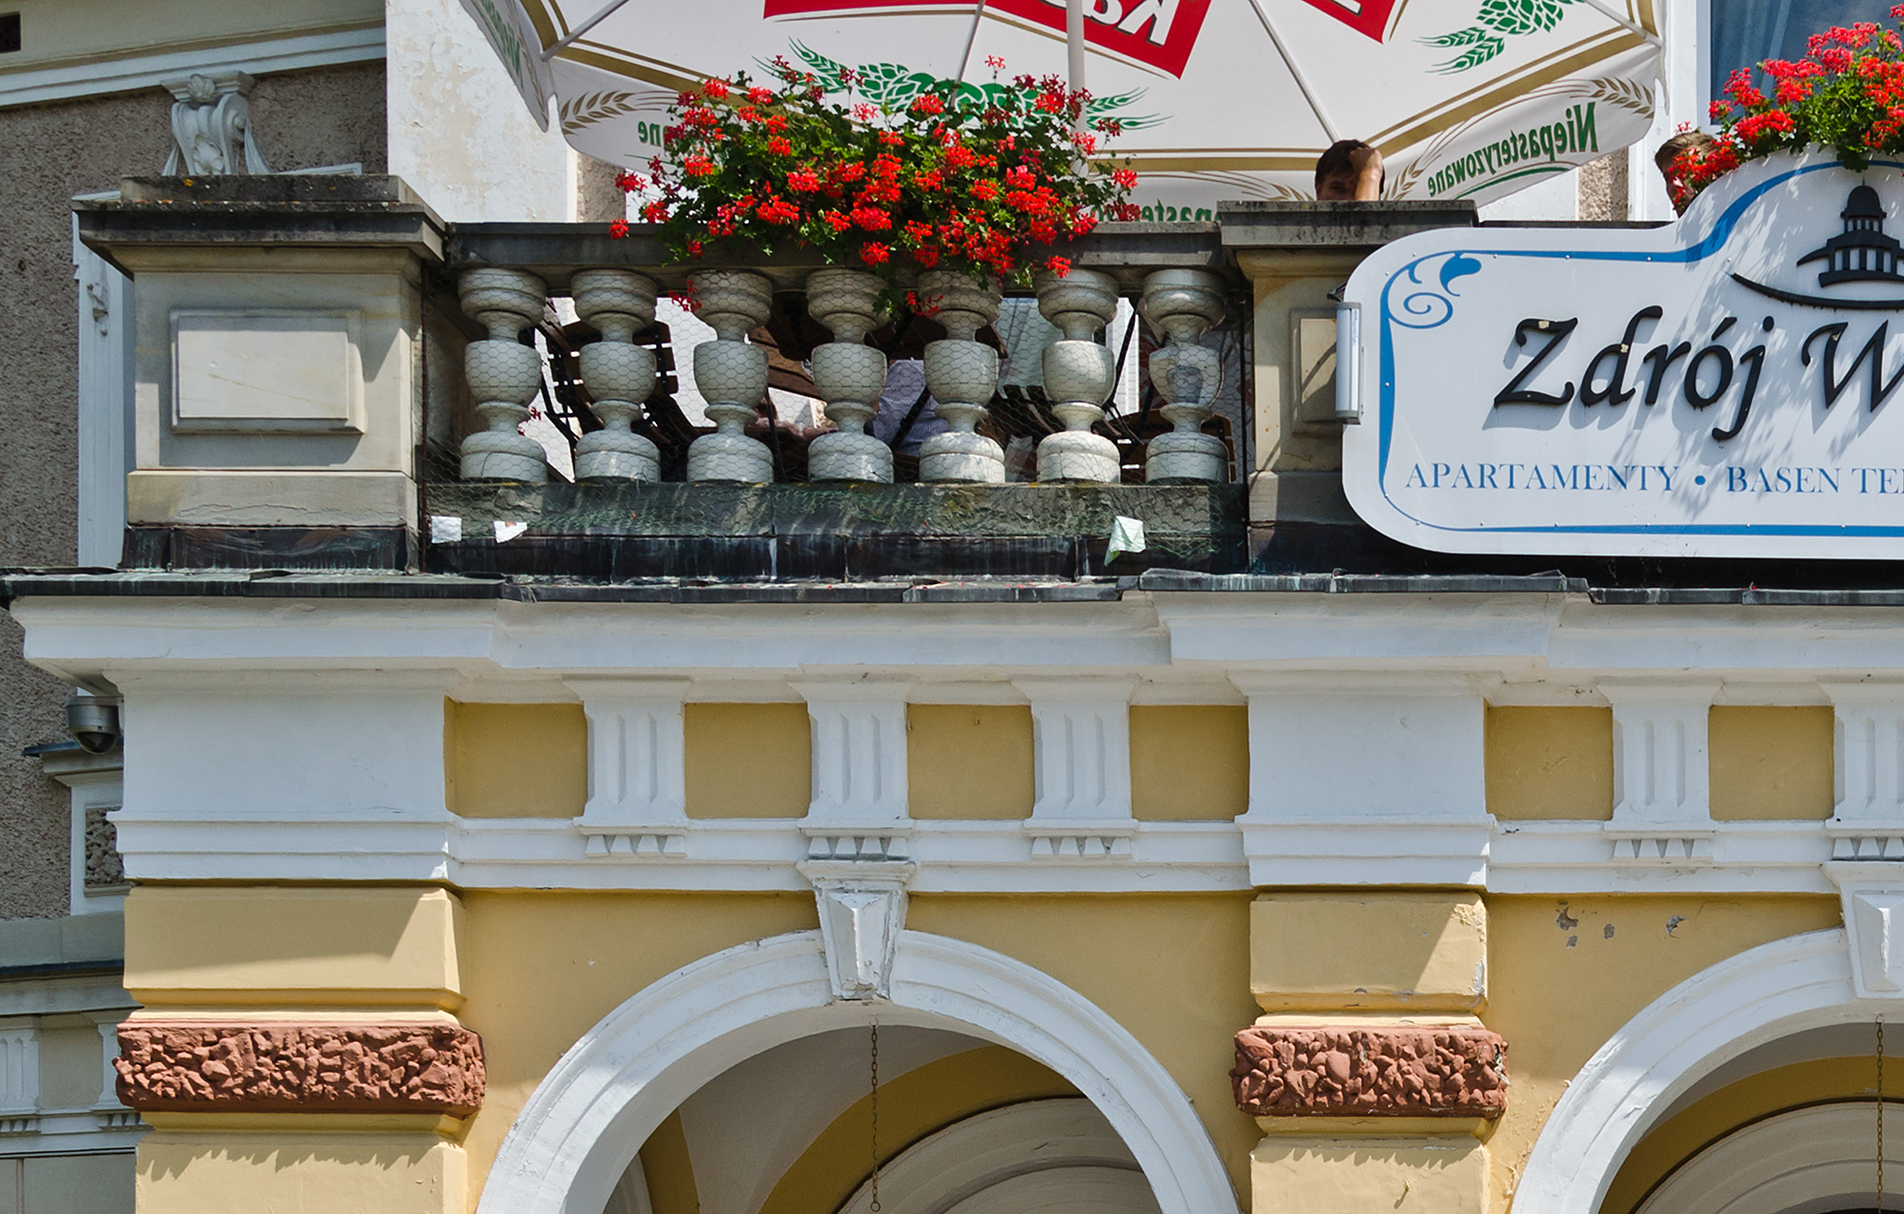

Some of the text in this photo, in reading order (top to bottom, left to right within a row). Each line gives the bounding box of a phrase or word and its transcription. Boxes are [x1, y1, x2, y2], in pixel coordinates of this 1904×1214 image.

[1493, 305, 1776, 443] Zdrój
[1405, 463, 1680, 494] APARTAMENTY
[1727, 466, 1842, 494] BASEN
